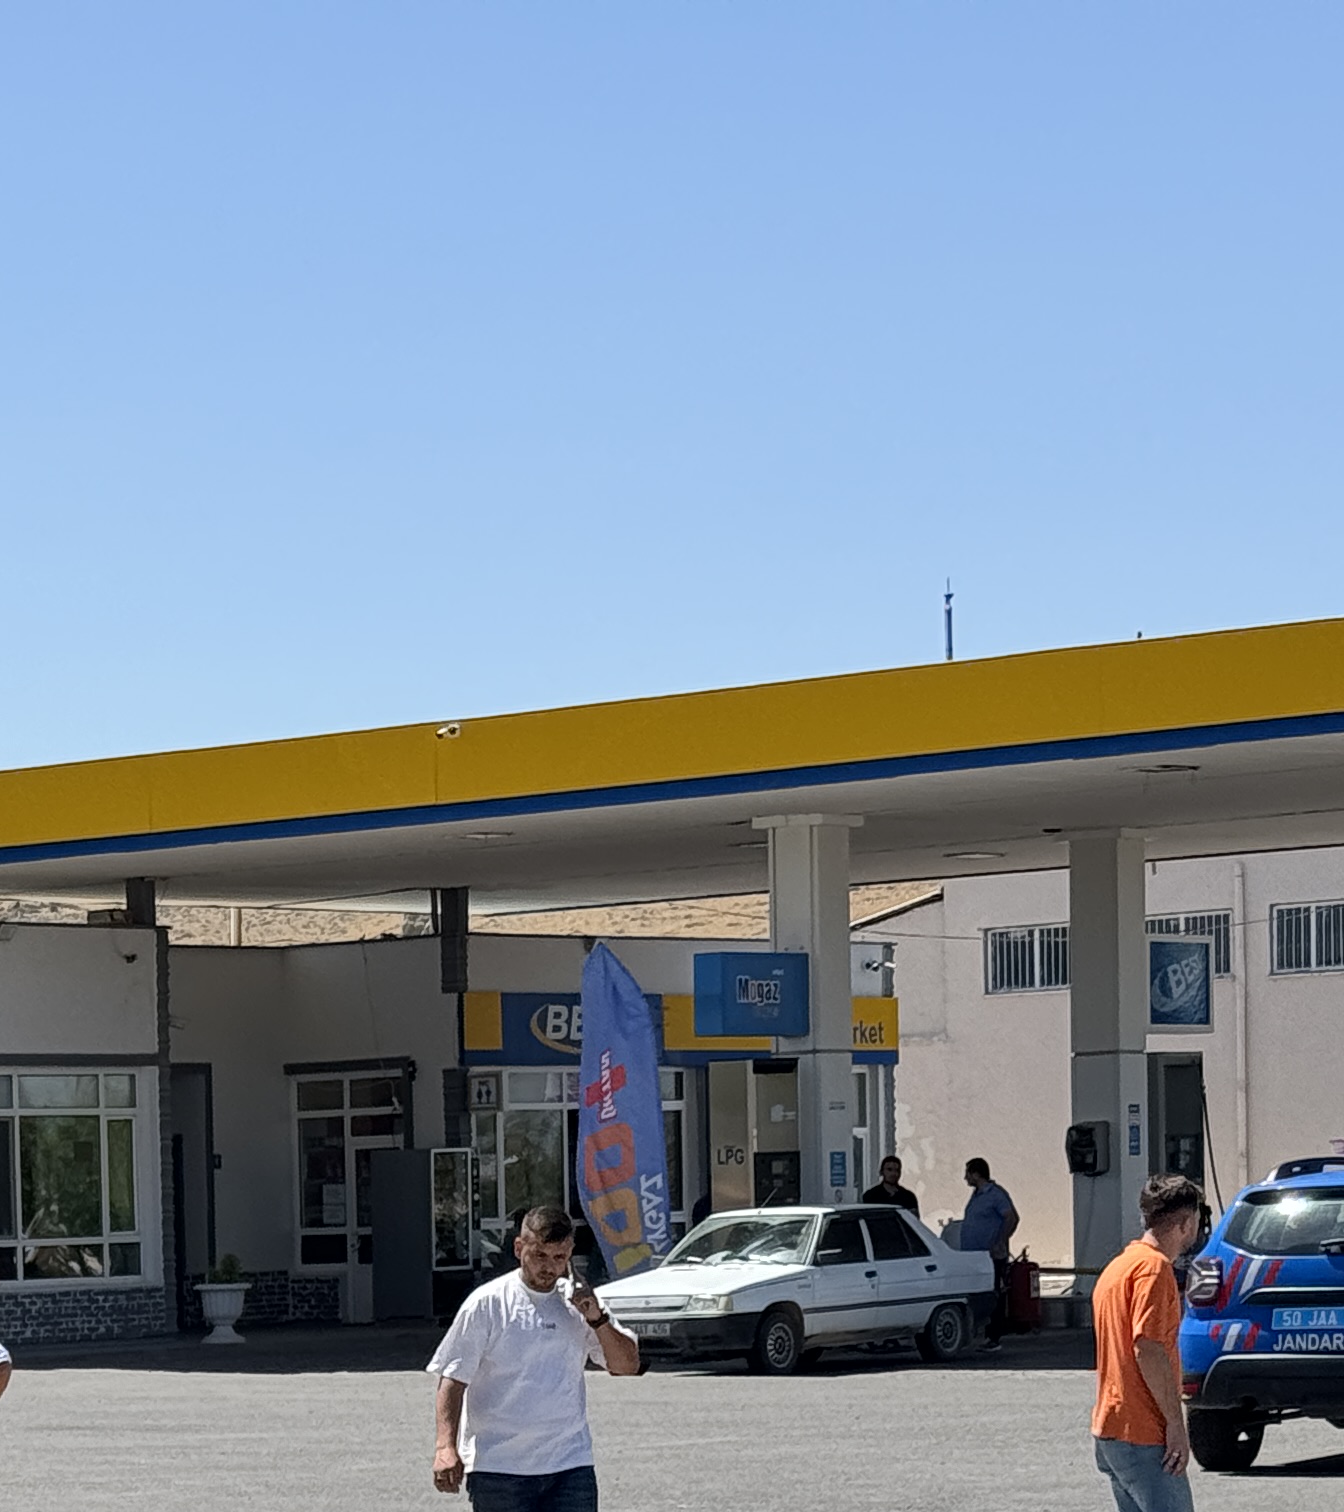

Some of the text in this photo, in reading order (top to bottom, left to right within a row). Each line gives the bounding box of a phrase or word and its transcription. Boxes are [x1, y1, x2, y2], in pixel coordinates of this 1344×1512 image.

[737, 976, 780, 1005] Mogaz
[545, 1004, 583, 1040] BE
[853, 1021, 884, 1045] rket
[717, 1149, 744, 1165] LPG
[1282, 1310, 1338, 1326] 50 JAA
